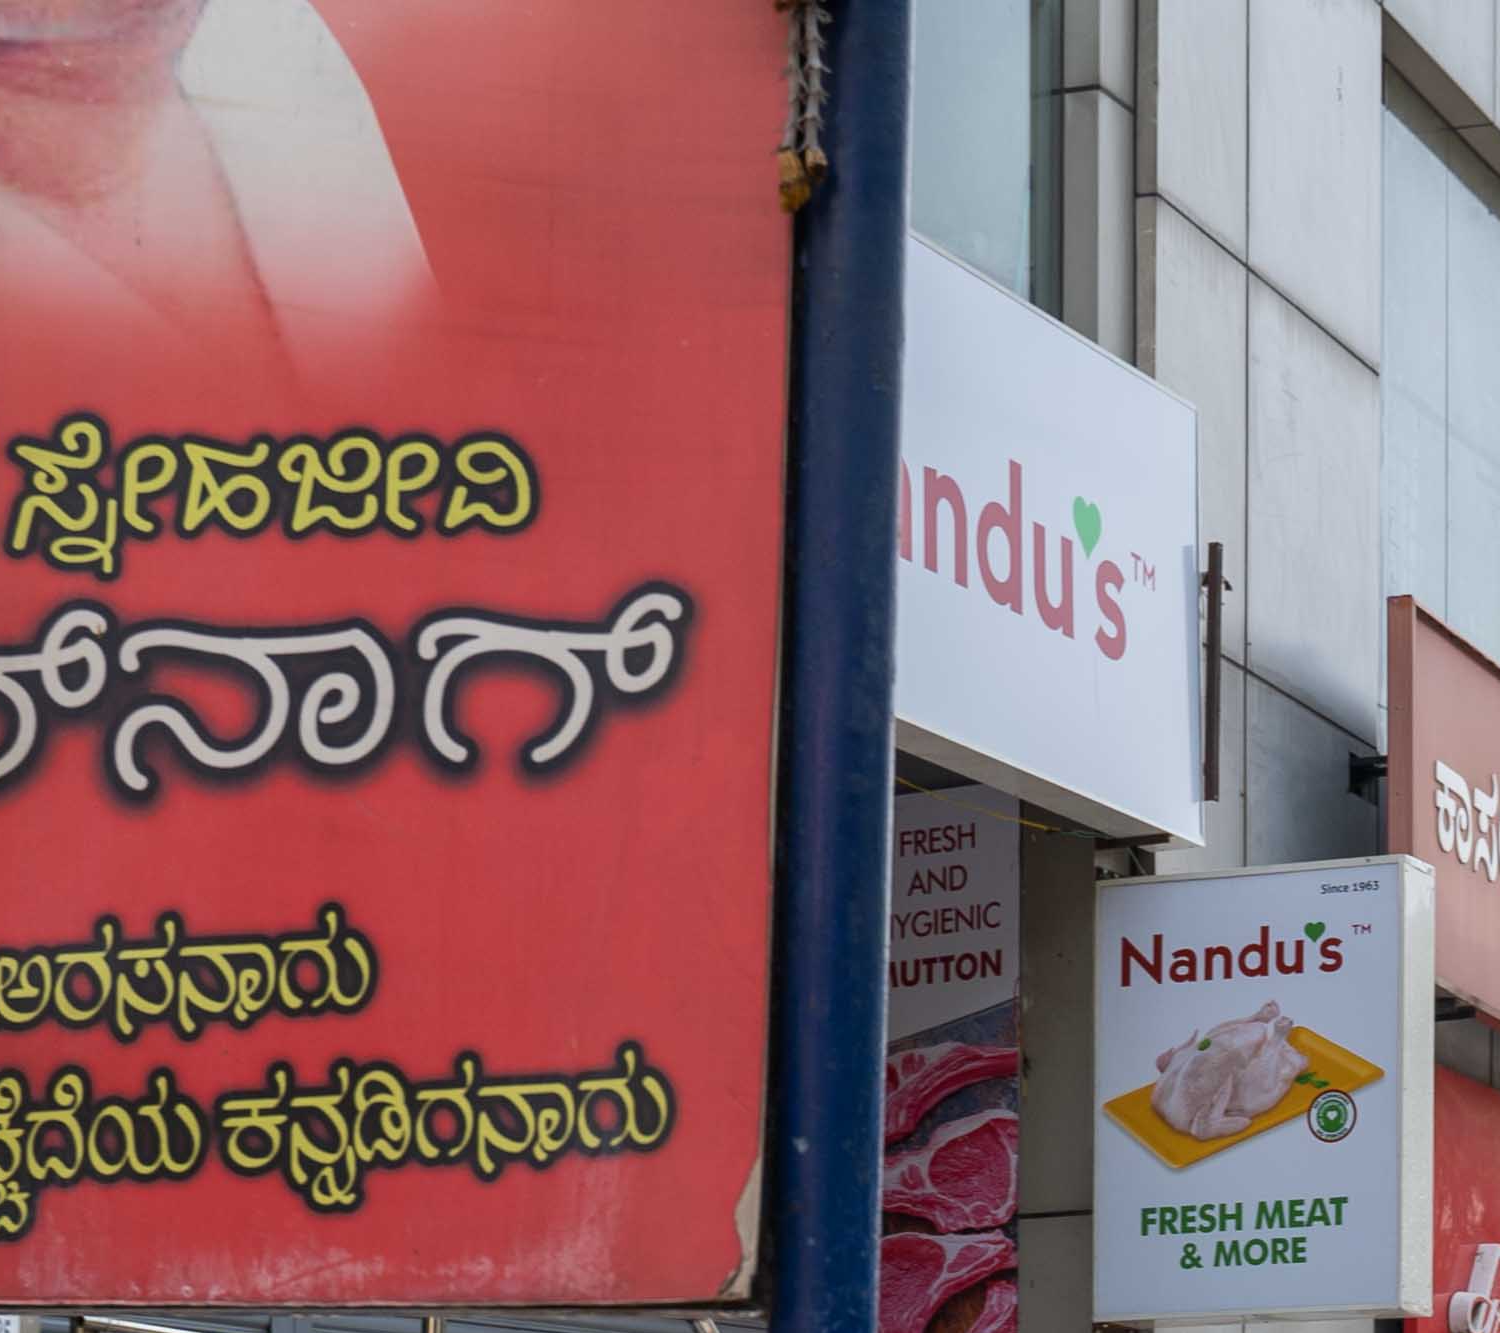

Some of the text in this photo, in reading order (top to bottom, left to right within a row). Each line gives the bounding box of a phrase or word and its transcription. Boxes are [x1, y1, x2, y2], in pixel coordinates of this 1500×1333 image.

[9, 415, 536, 577] ಸ್ನೇಹಜೀವಿ
[899, 823, 976, 857] FRESH
[907, 864, 968, 896] AND
[1321, 879, 1380, 894] Since 1963
[1120, 921, 1344, 987] Nandu's
[219, 1046, 672, 1209] ಕನ್ನಡಿಗನಾಗು
[1140, 1196, 1349, 1237] FRESH MEAT
[1179, 1236, 1308, 1269] & MORE
